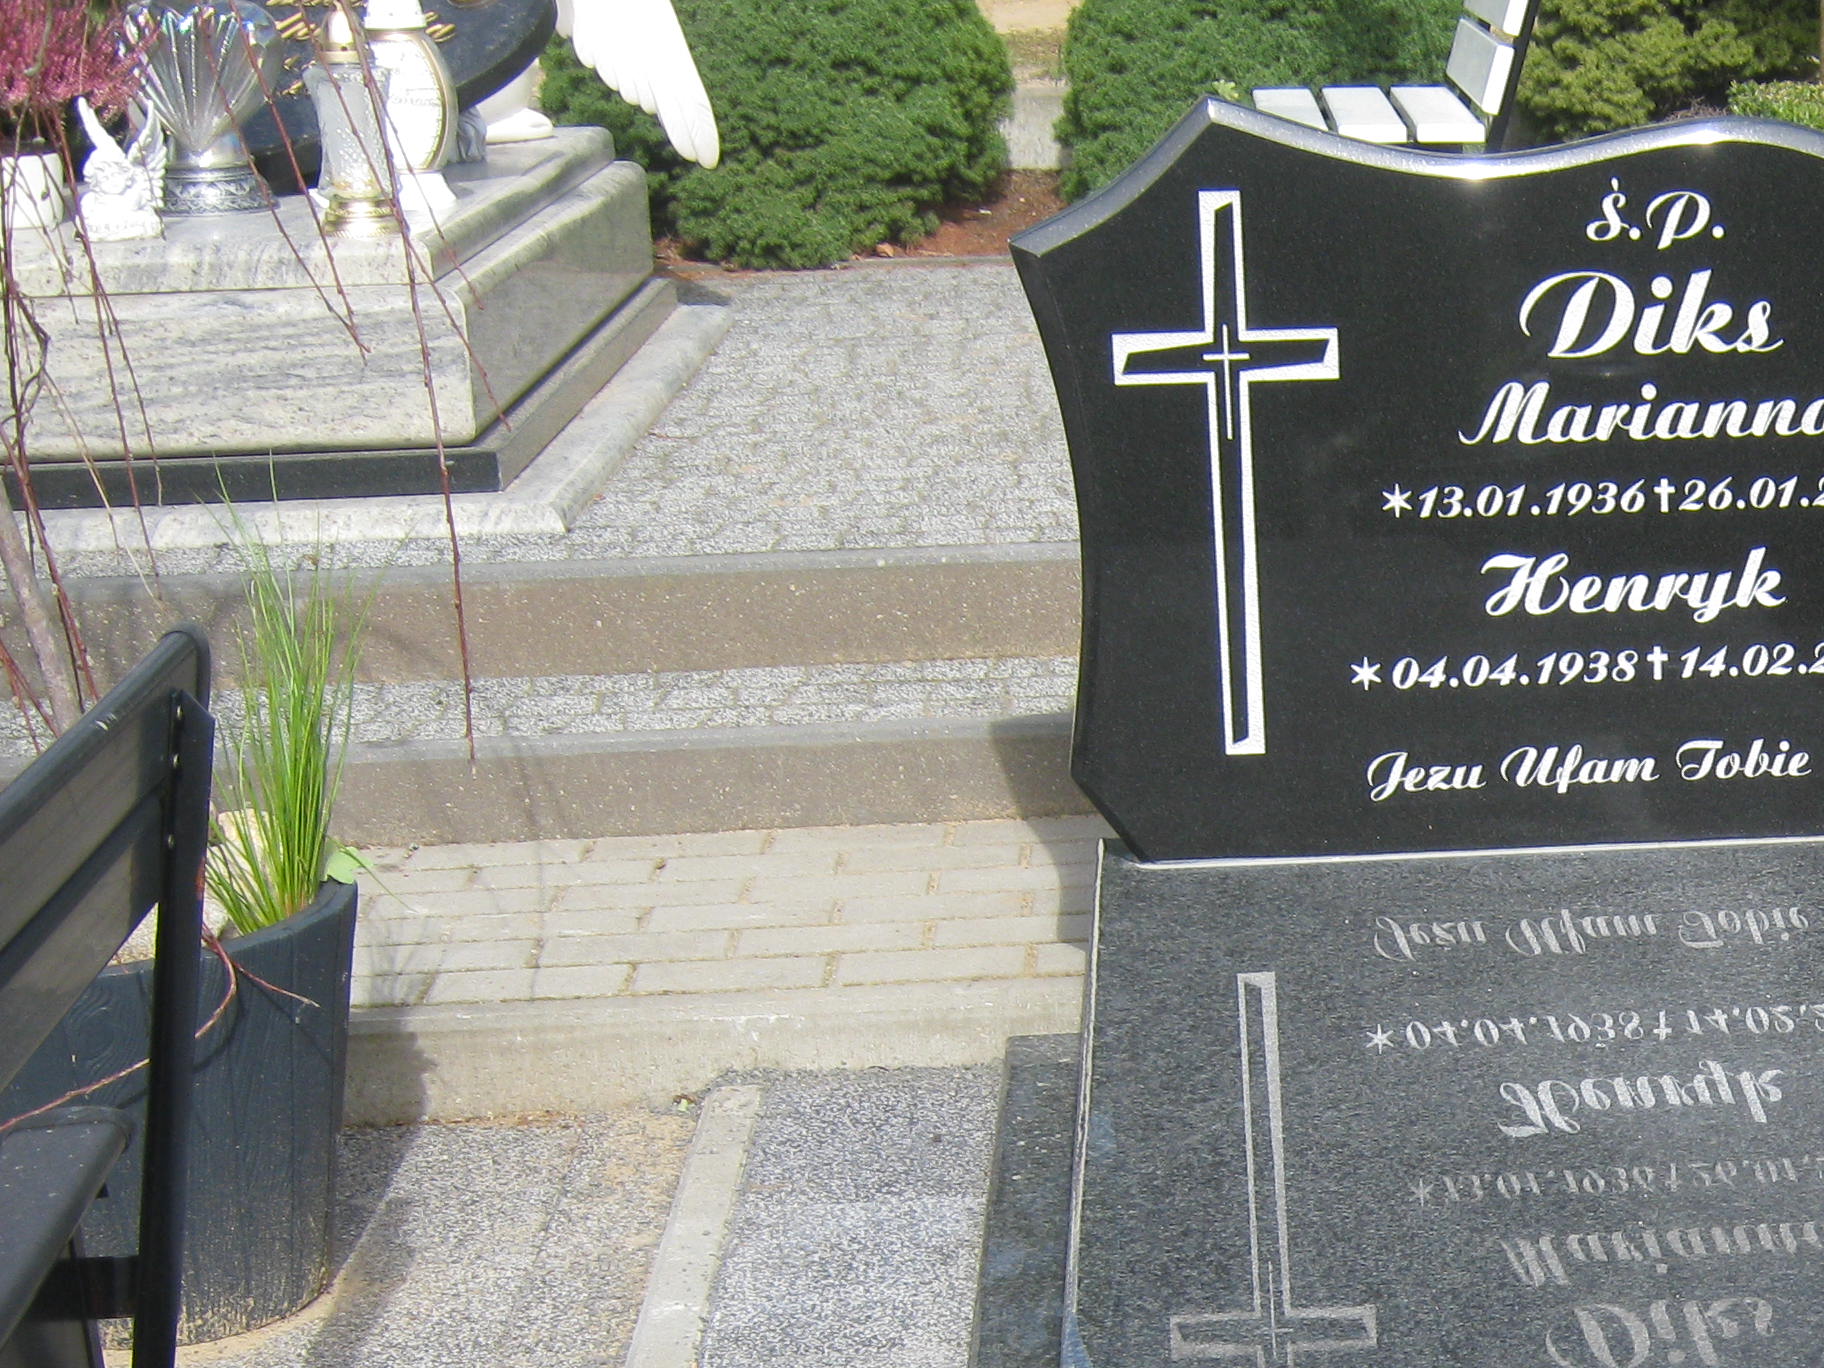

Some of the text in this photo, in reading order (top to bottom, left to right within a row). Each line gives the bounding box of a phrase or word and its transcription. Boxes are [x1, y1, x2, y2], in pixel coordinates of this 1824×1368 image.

[1519, 269, 1783, 358] Diks
[1481, 547, 1786, 623] Henryk
[1367, 739, 1812, 801] Jezu Ufam Tobie
